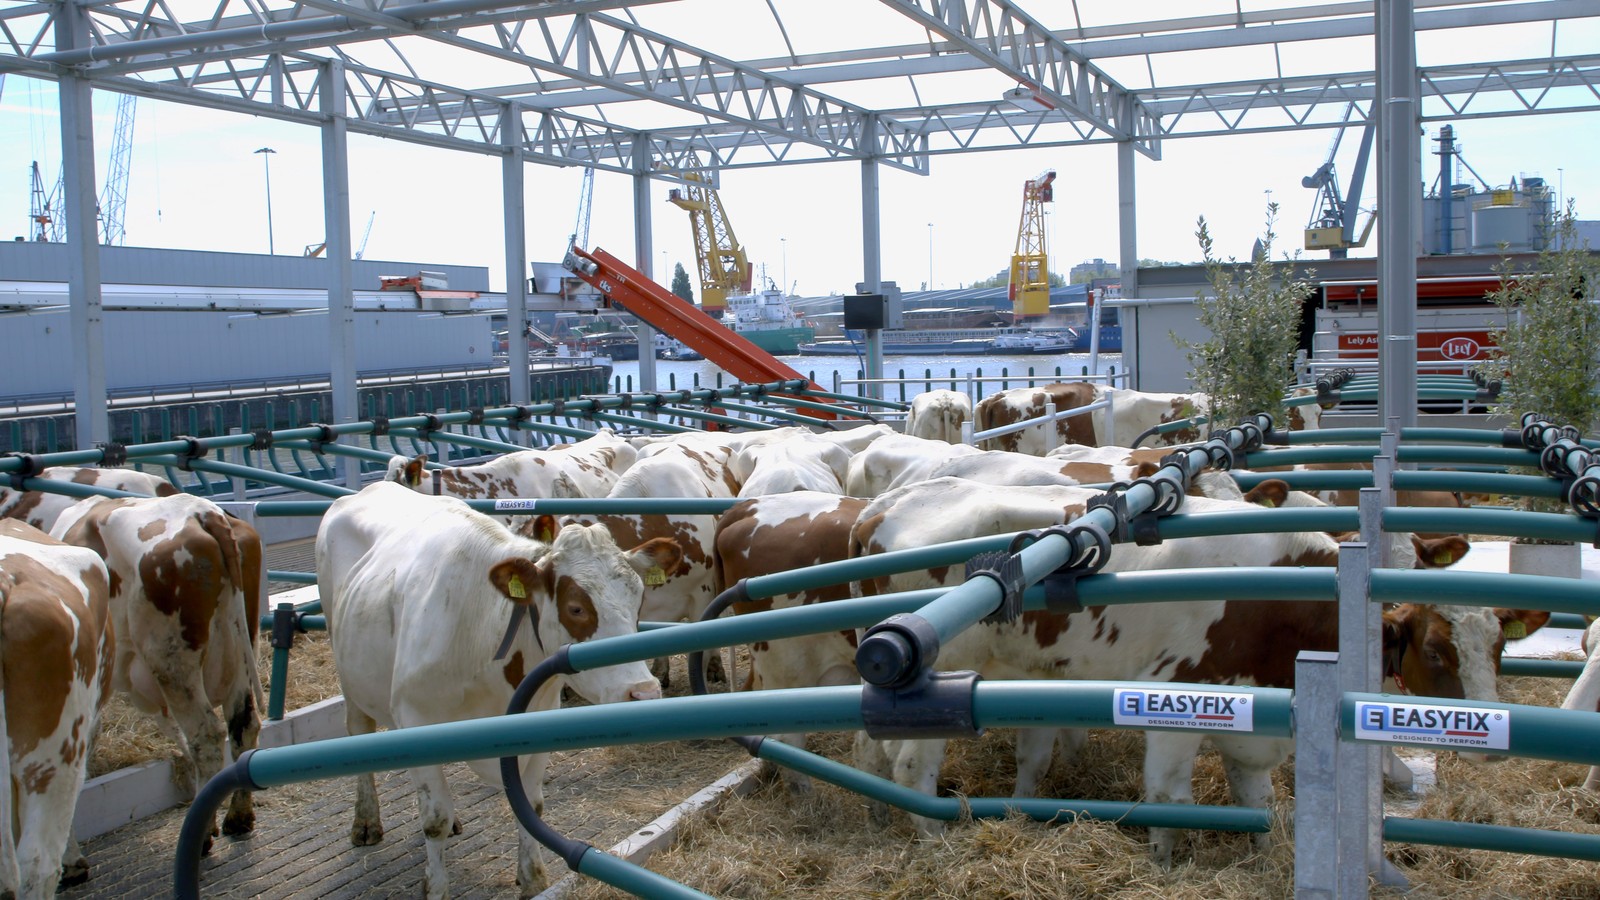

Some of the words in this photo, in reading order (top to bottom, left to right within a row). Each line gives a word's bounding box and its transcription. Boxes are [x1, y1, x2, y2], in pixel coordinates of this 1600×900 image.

[1347, 336, 1365, 346] Lely
[1448, 342, 1472, 357] LELY
[1147, 694, 1236, 715] EASYFIX
[1392, 707, 1490, 731] EASYFIX
[1392, 734, 1433, 743] DESIGNED
[1449, 738, 1488, 746] PERFORM
